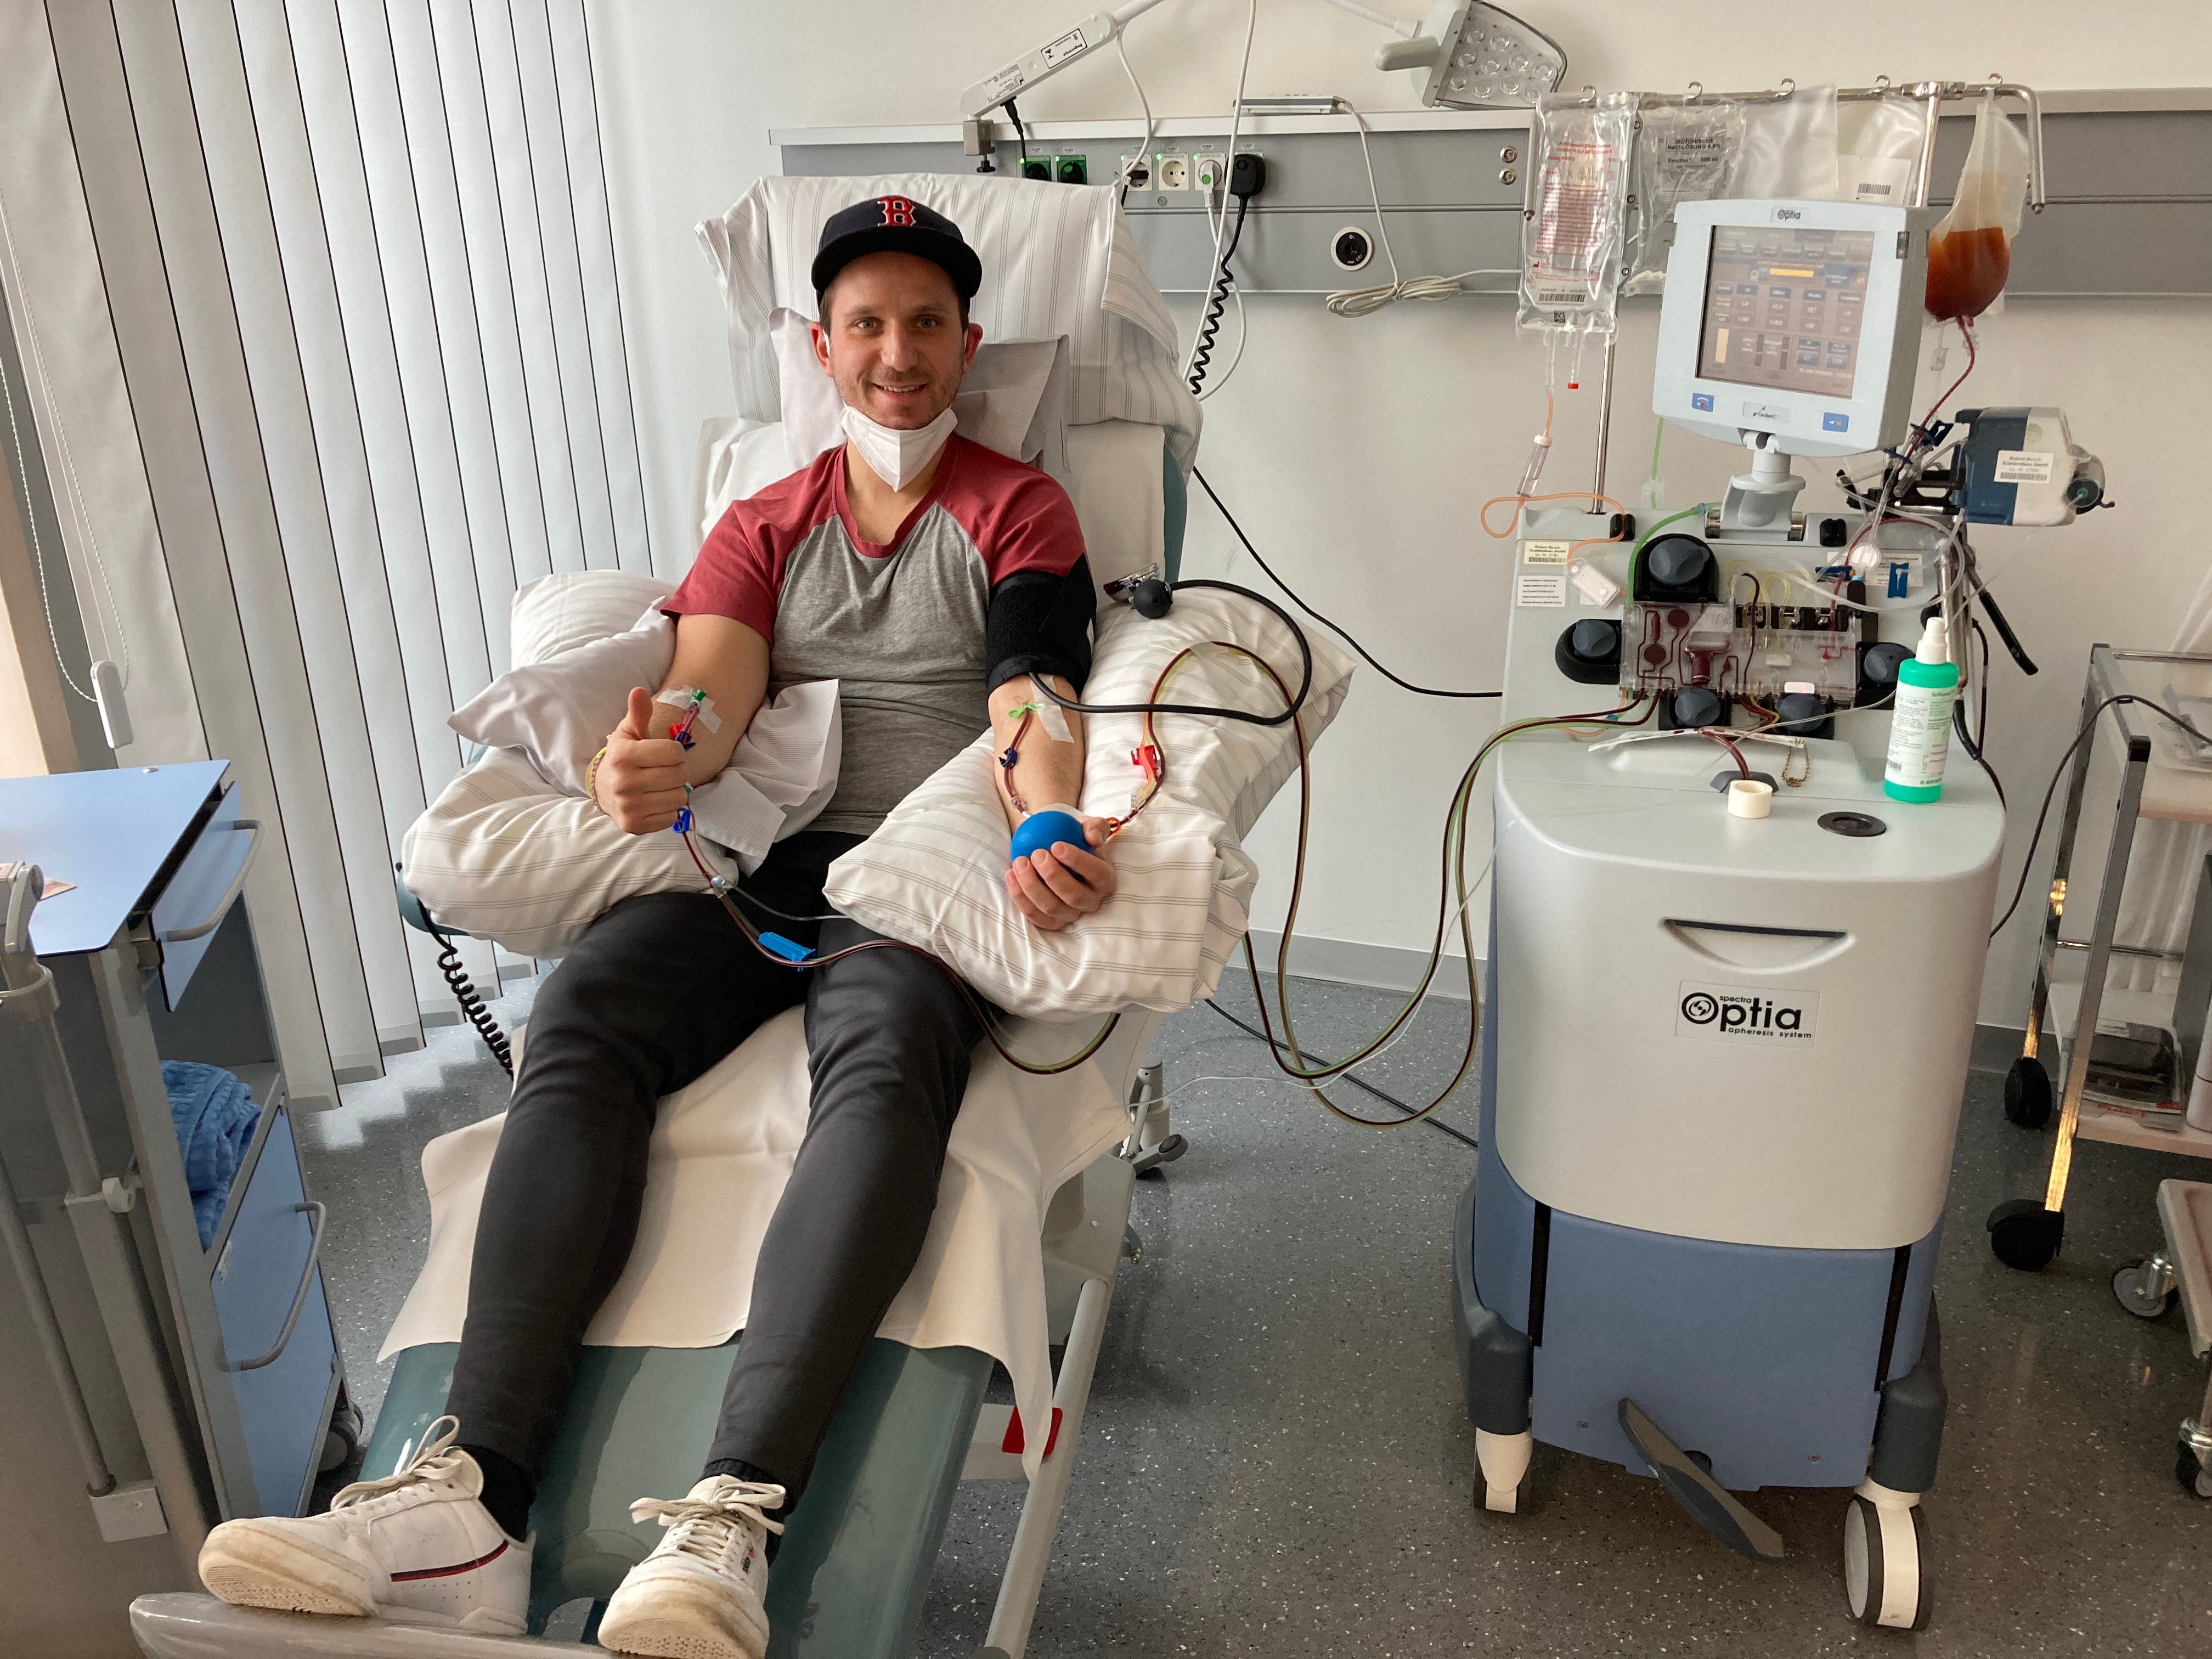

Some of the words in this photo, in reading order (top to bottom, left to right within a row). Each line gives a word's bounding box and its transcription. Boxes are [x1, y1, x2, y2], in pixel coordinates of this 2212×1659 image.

[877, 195, 917, 227] B
[1719, 995, 1752, 1004] spectra
[1681, 992, 1802, 1032] Optia
[1728, 1028, 1774, 1036] apheresis
